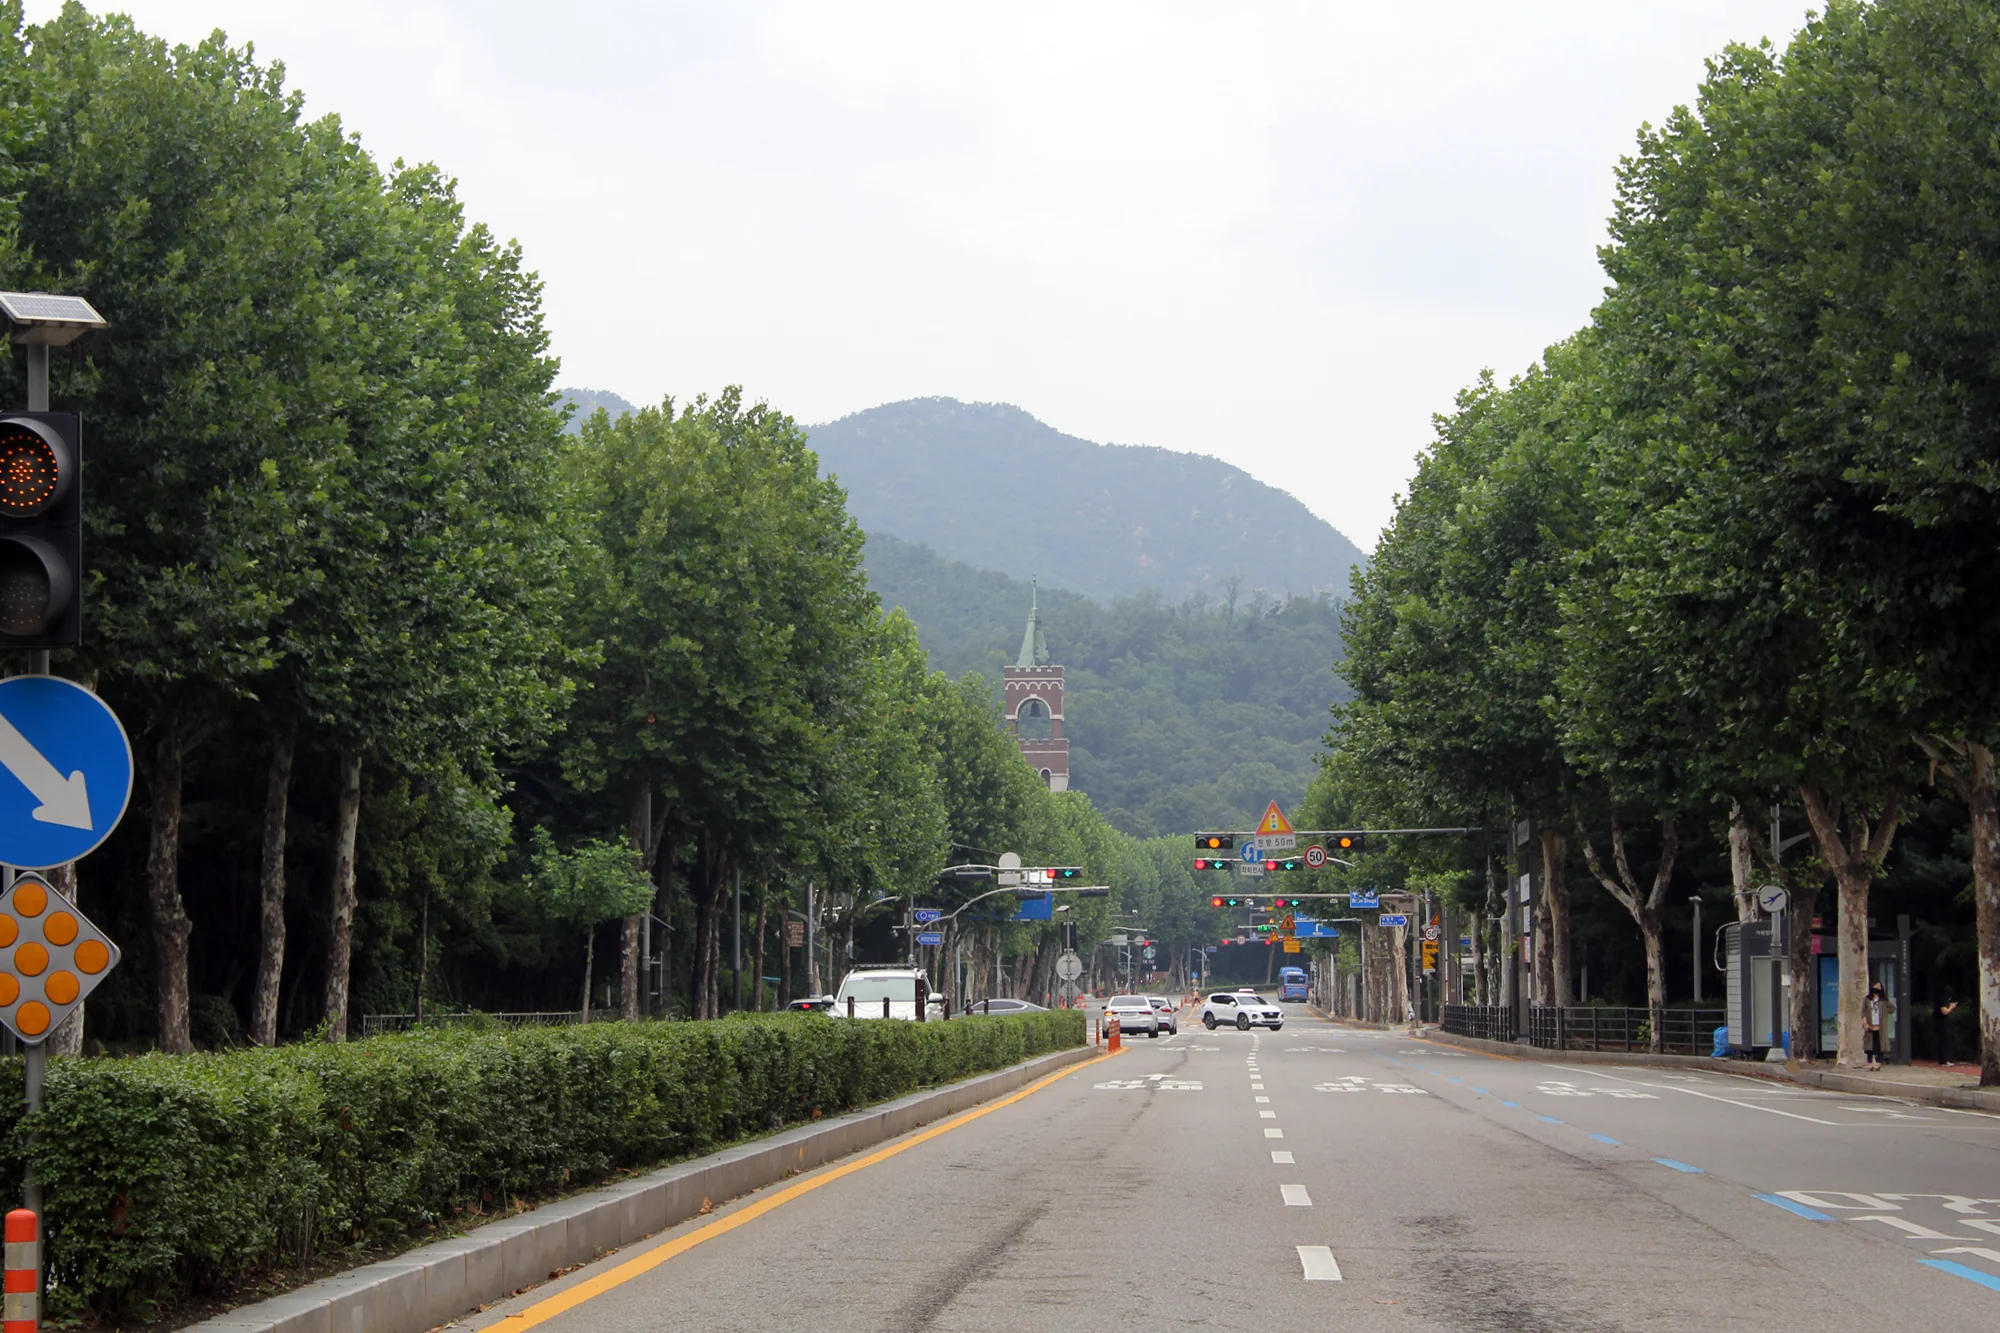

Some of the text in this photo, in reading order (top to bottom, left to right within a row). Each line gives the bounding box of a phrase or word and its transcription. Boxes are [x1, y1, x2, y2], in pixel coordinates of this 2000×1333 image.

[1275, 837, 1294, 847] 50m
[1309, 851, 1322, 862] 50
[1427, 930, 1437, 938] 50
